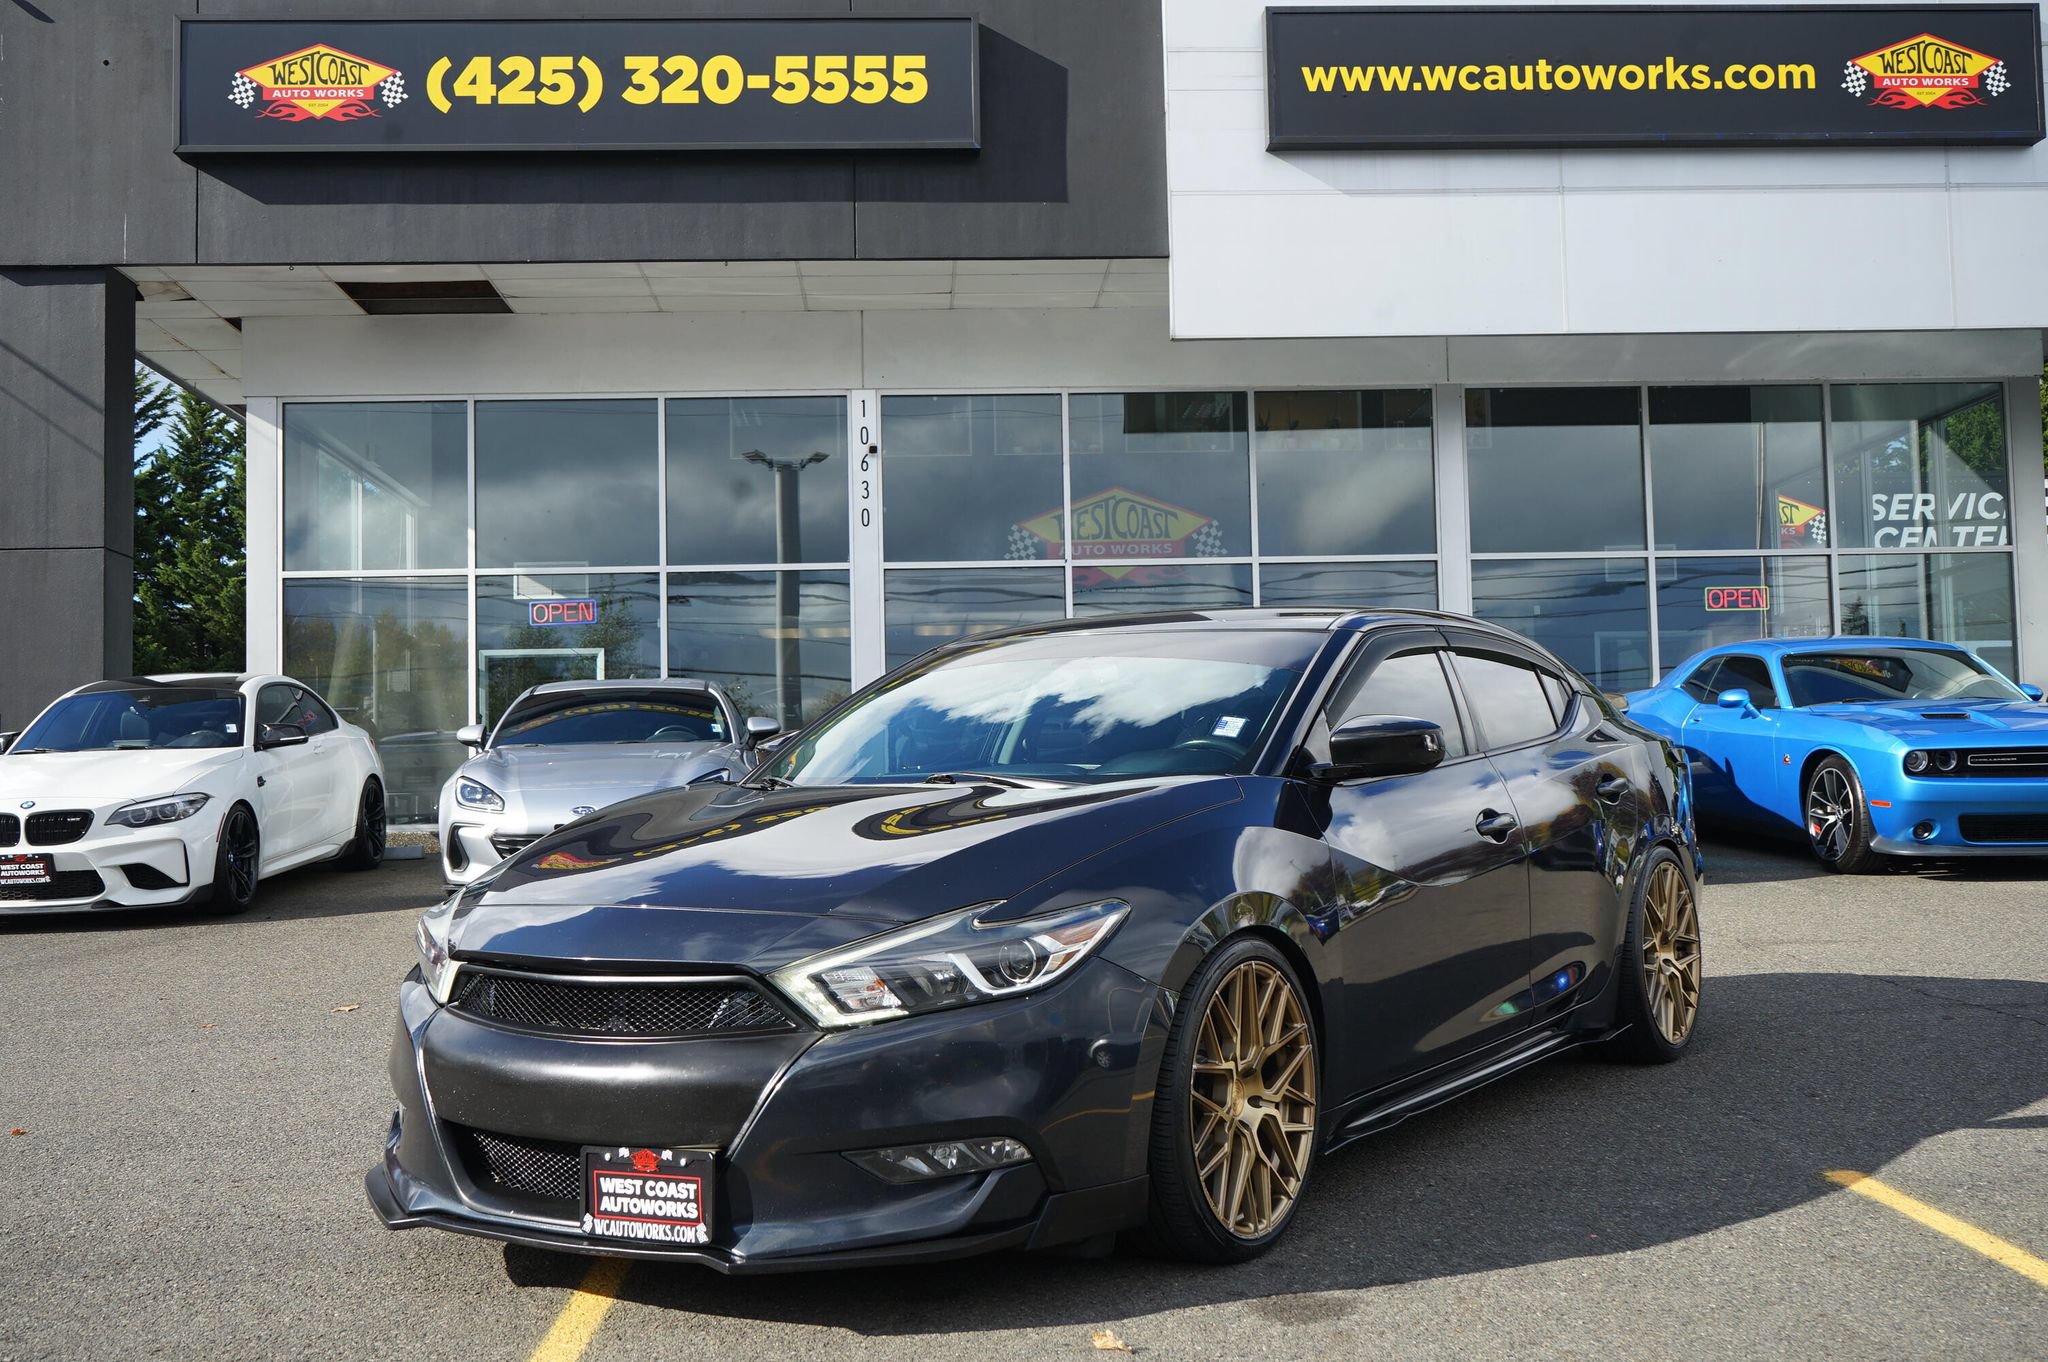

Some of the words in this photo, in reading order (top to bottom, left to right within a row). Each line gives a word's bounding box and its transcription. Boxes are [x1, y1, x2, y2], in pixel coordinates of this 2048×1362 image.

[426, 56, 603, 114] (425)
[621, 54, 929, 105] 320-5555
[1301, 57, 1817, 92] www.wcautoworks.com
[1882, 77, 1919, 87] AUTO
[1922, 77, 1969, 87] WORKS
[272, 88, 311, 99] AUTO
[313, 88, 365, 99] WORKS
[1872, 492, 2007, 521] SERVIC
[1109, 543, 1173, 555] WORKS
[1707, 589, 1767, 609] OPEN
[532, 602, 594, 623] OPEN
[599, 1177, 643, 1195] WEST
[645, 1180, 697, 1199] COAST
[600, 1196, 699, 1219] AUTOWORKS
[593, 1218, 696, 1244] WCAUTOWORKS.COM
